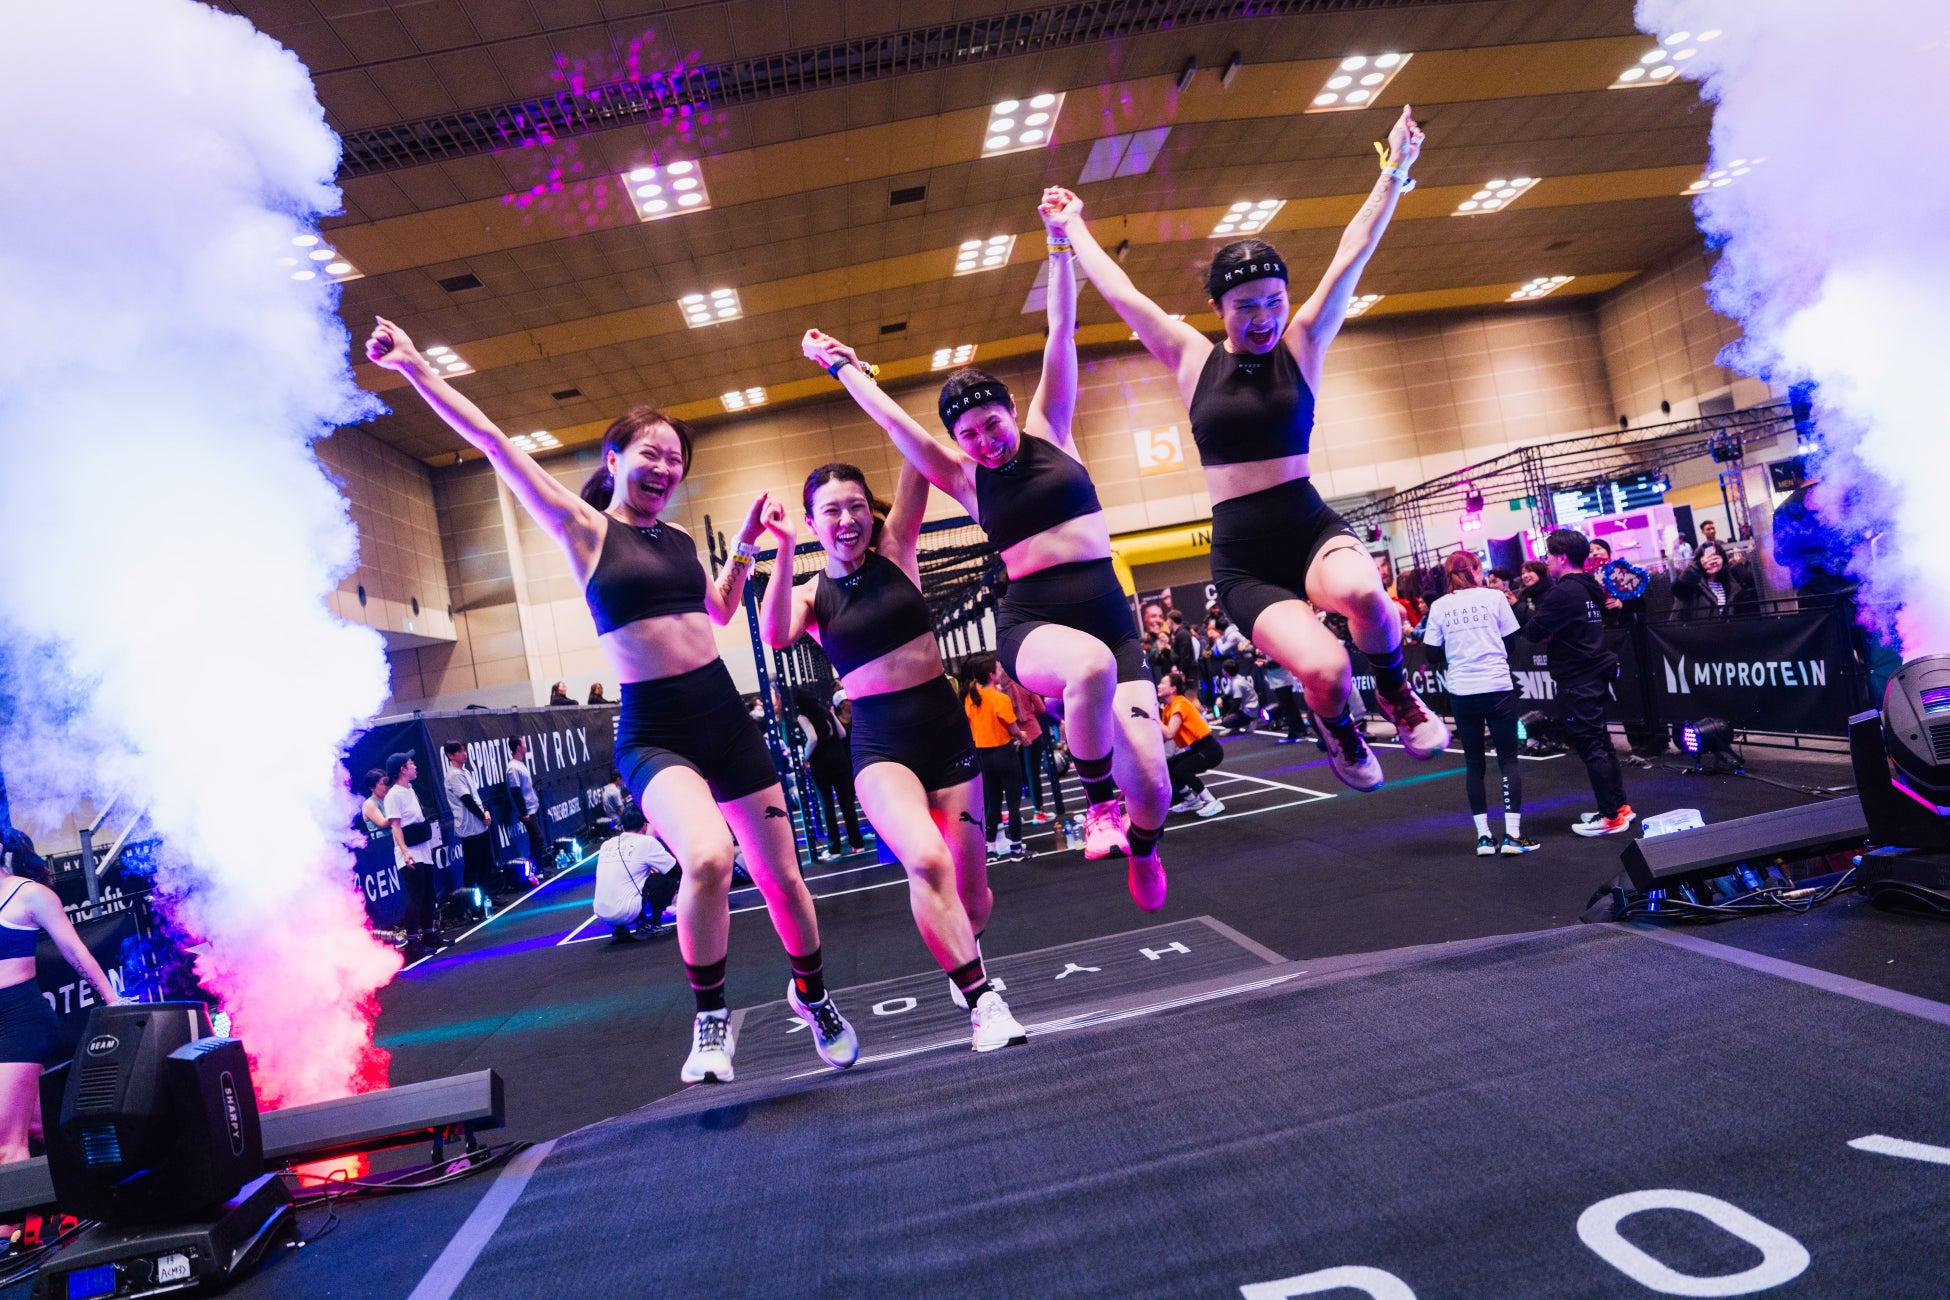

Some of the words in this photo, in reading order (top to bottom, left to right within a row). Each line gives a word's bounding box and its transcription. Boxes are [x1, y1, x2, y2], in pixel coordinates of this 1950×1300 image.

[1150, 427, 1176, 463] 5
[1445, 606, 1478, 619] HEAD
[1445, 613, 1489, 628] JUDGE
[1694, 659, 1827, 687] MYPROTEIN
[467, 739, 505, 790] SPORT
[522, 727, 591, 776] HYROX
[90, 1040, 116, 1051] BEAM
[225, 1087, 240, 1138] SHARPY
